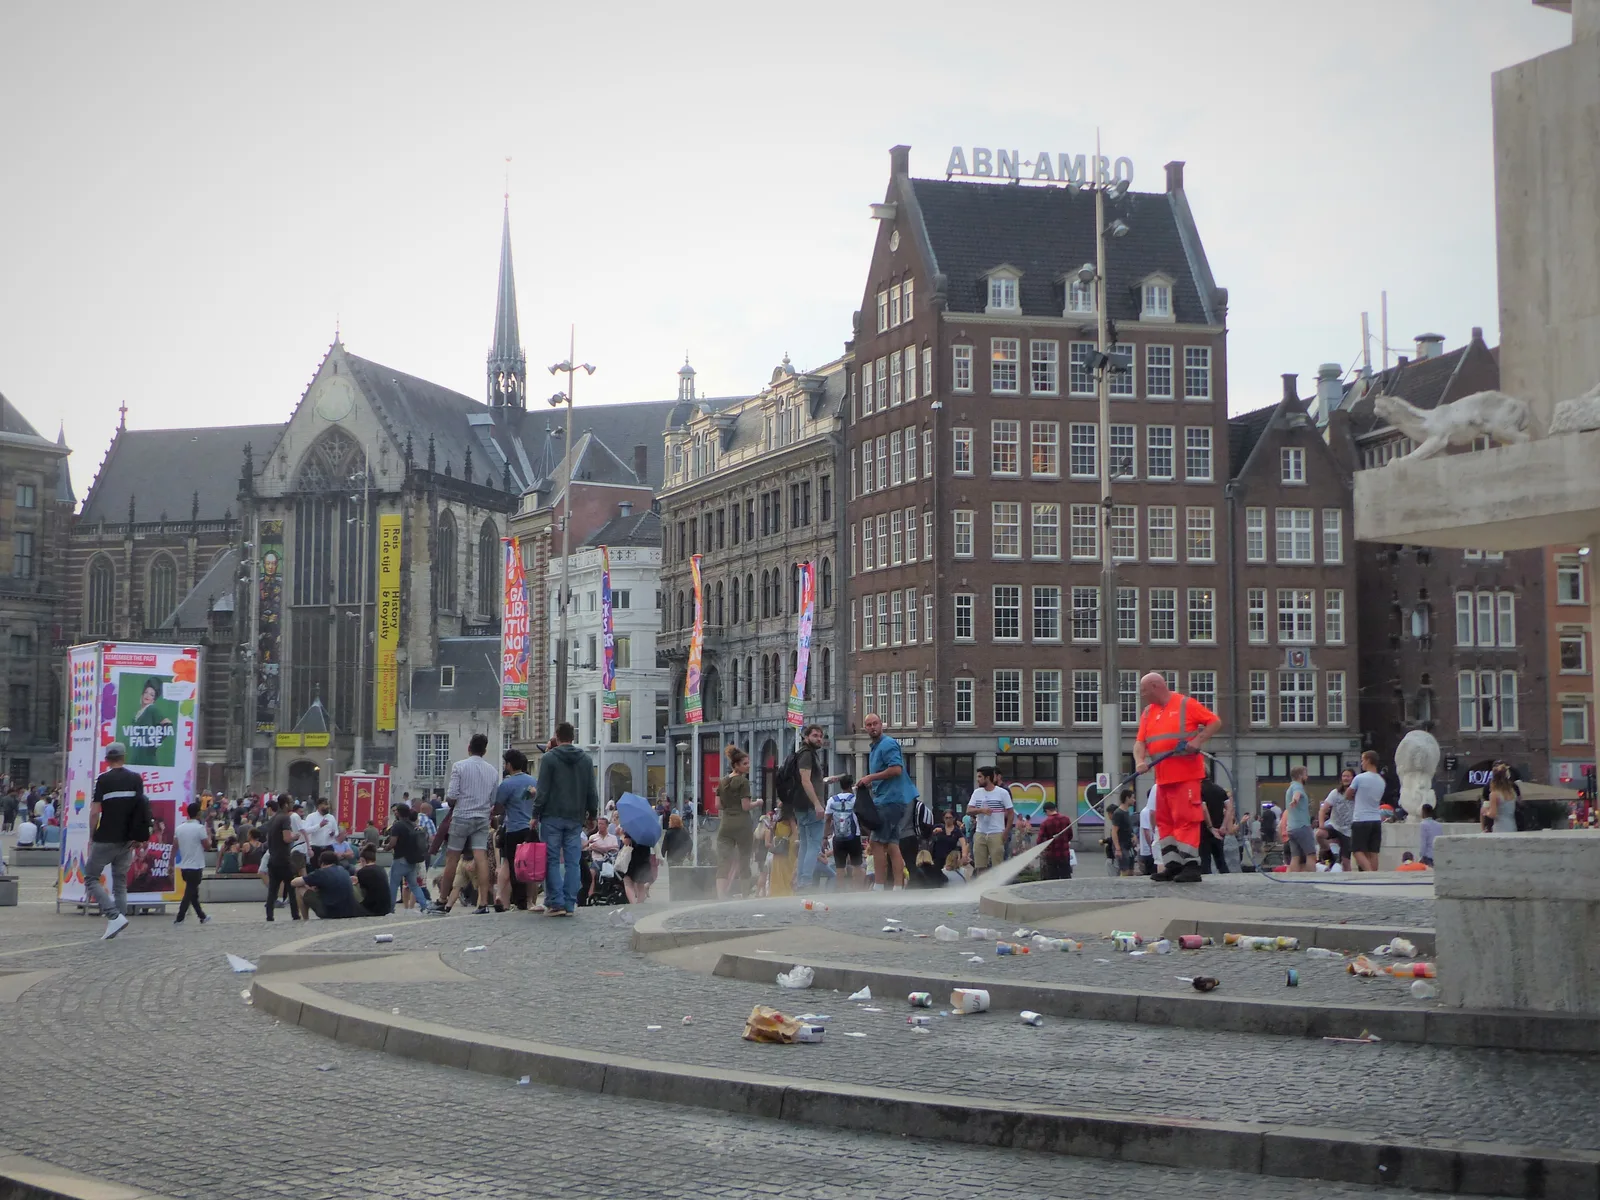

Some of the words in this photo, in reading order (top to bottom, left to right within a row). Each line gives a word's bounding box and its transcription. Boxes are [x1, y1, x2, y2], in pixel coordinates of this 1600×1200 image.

[383, 528, 391, 539] in
[392, 528, 401, 550] Reis
[383, 540, 391, 554] de
[381, 555, 391, 573] tijd
[382, 590, 390, 598] &
[389, 590, 400, 629] History
[380, 601, 390, 640] Royalty
[122, 725, 175, 737] VICTORIA
[129, 736, 163, 748] FALSE
[144, 780, 174, 794] TEST
[342, 779, 350, 819] DRINKS
[377, 780, 385, 826] HOTDOGS
[154, 859, 170, 868] VIN
[151, 868, 169, 877] YAR
